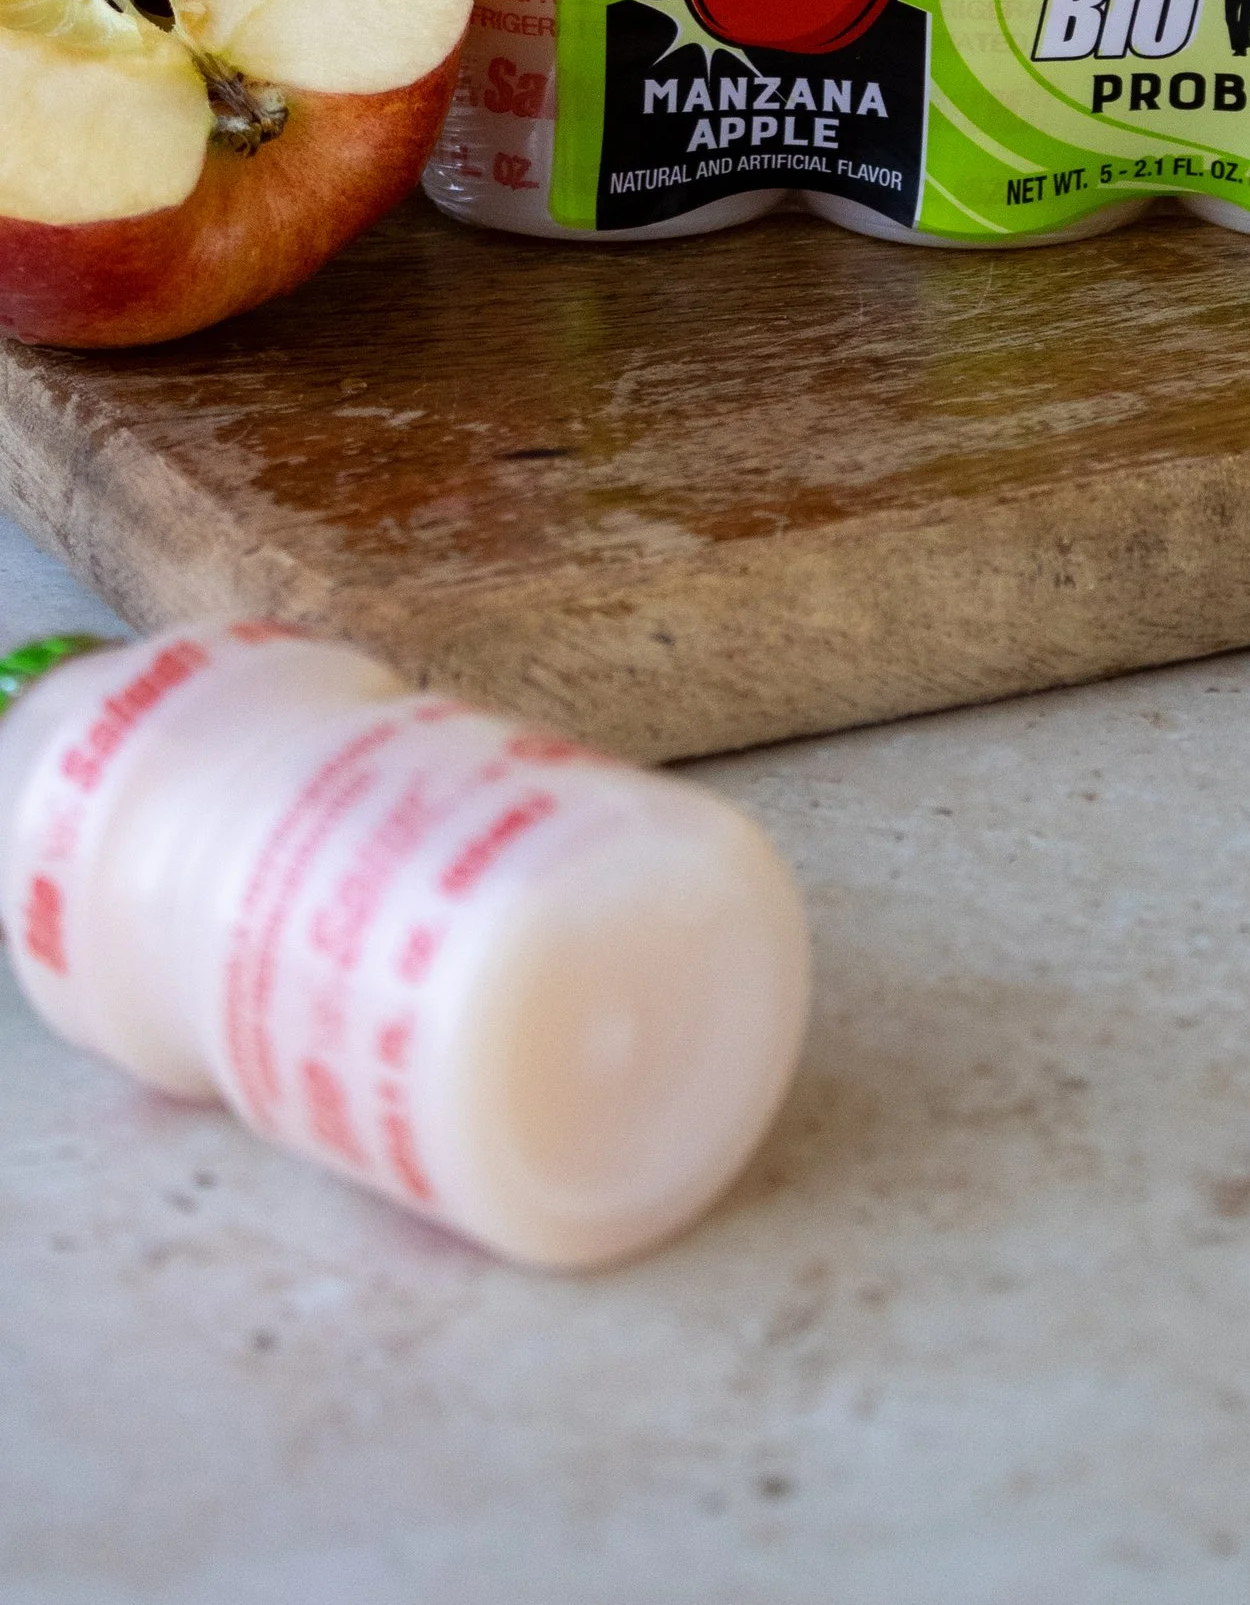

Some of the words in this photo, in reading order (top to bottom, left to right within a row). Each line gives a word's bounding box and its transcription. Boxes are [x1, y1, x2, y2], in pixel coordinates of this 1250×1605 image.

[642, 77, 890, 118] MANZANA
[686, 117, 840, 154] APPLE
[609, 164, 692, 195] NATURAL
[696, 156, 733, 179] AND
[737, 153, 832, 173] ARTIFICIAL
[837, 159, 903, 192] FLAVOR
[1006, 174, 1046, 206] NET
[1053, 167, 1088, 197] WT.
[1100, 163, 1113, 184] 5
[1134, 158, 1164, 179] 2.1
[1173, 157, 1204, 177] FL.
[1210, 159, 1244, 184] OZ.
